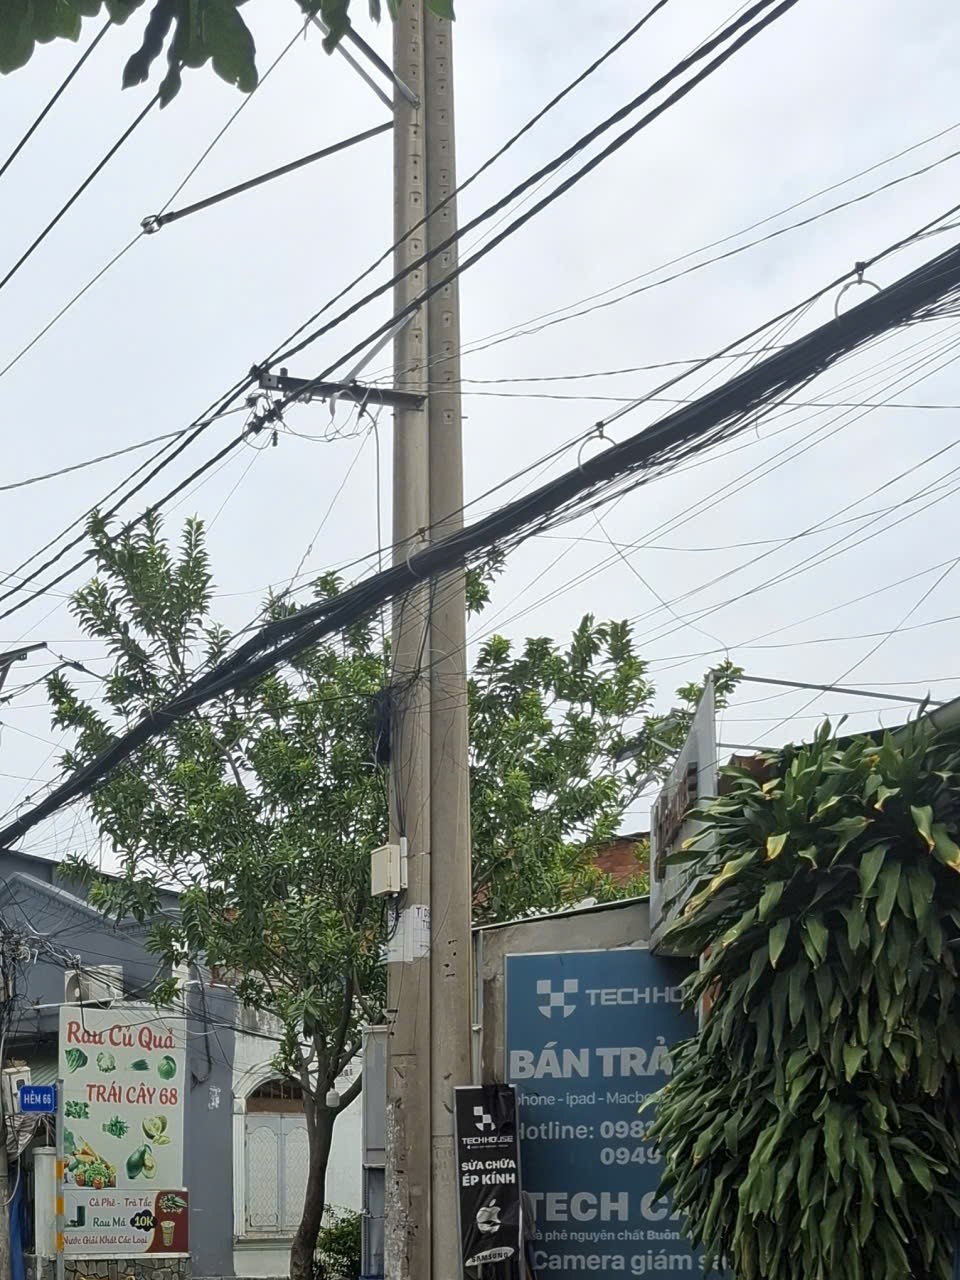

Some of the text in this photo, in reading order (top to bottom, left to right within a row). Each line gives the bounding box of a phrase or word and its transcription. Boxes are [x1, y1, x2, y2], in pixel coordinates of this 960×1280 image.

[585, 987, 689, 1006] TECHHO
[67, 1020, 175, 1051] Rau Củ Quả
[510, 1041, 589, 1079] BÁN
[23, 1090, 40, 1104] HẺM
[86, 1081, 178, 1105] TRÁI CÂY 68
[566, 1091, 595, 1107] ipad
[461, 1158, 516, 1171] SỬA CHỮA
[462, 1171, 516, 1187] ÉP KÍNH
[89, 1197, 100, 1207] Cà
[101, 1198, 116, 1207] Phê
[124, 1198, 137, 1207] Trà
[93, 1217, 126, 1227] Rau Má
[134, 1216, 154, 1227] 10K
[118, 1235, 132, 1244] Các
[545, 1229, 567, 1242] phê
[570, 1229, 615, 1243] nguyên
[618, 1228, 644, 1241] chất
[647, 1229, 680, 1240] Buôn
[472, 1252, 509, 1262] SAMSUNG
[534, 1251, 625, 1271] Camera
[630, 1249, 692, 1275] giám
